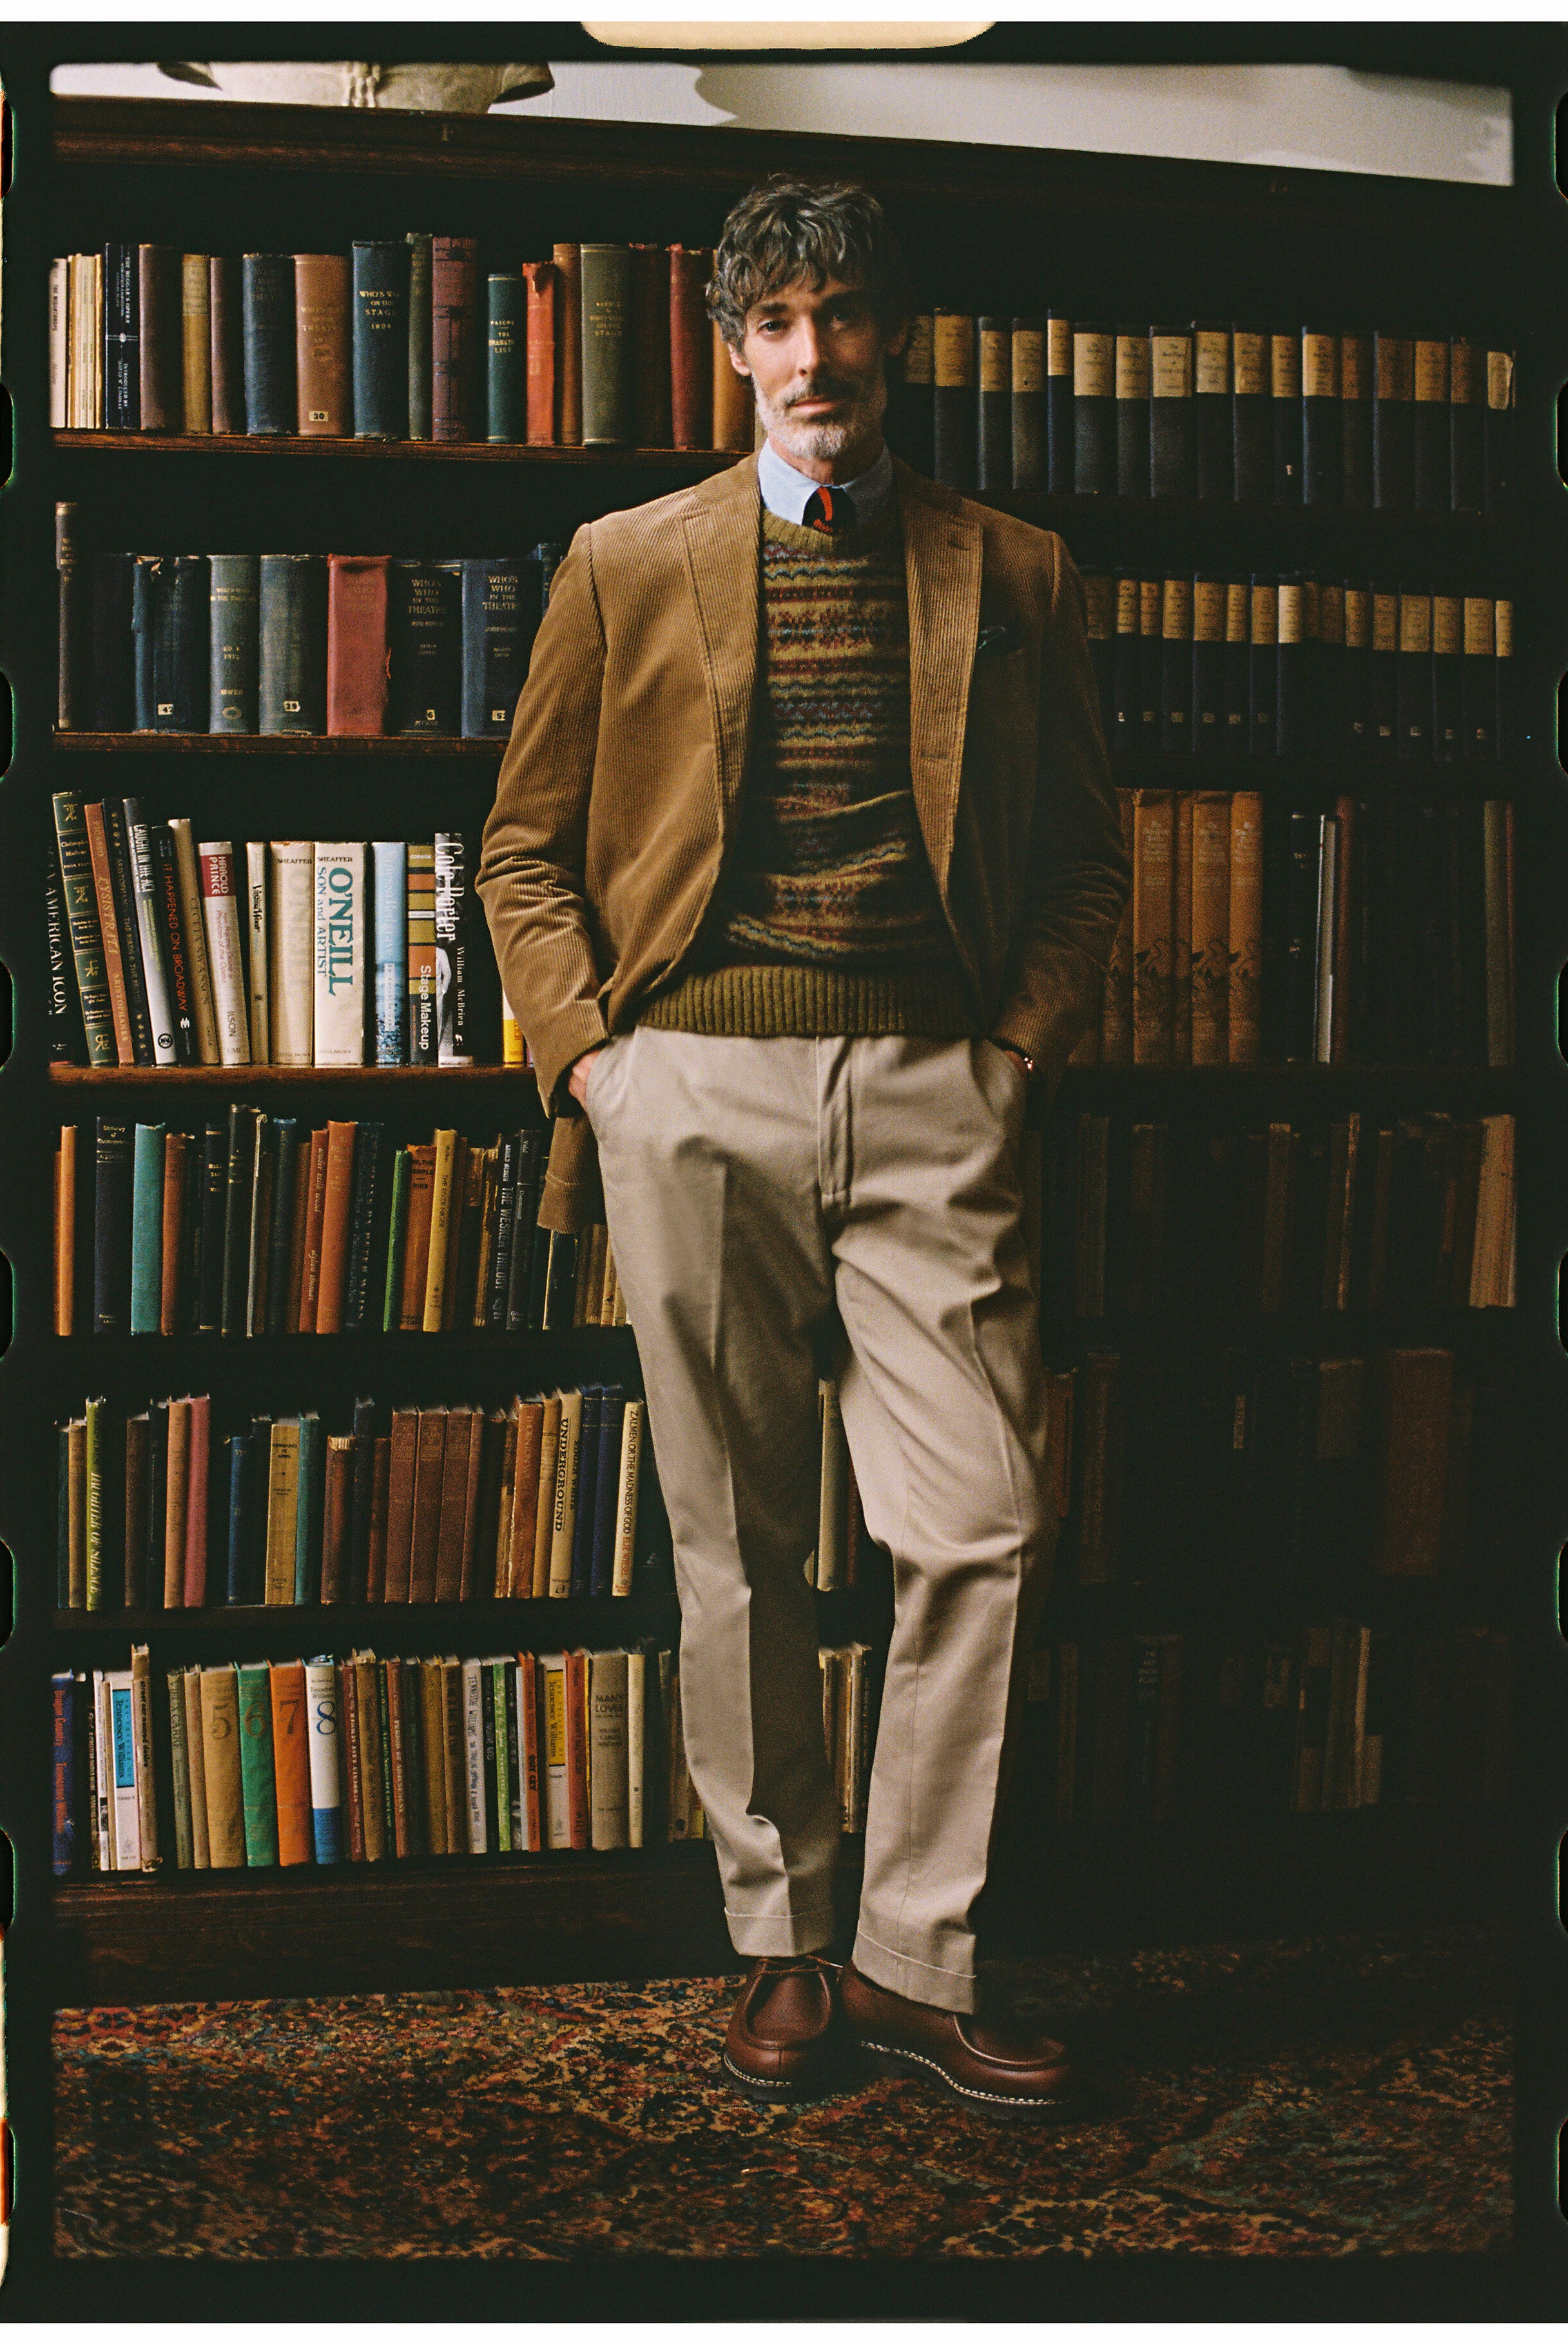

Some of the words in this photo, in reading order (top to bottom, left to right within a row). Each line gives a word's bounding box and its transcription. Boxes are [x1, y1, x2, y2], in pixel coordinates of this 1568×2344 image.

[95, 820, 105, 857] PICASSO
[135, 824, 150, 852] CAUGHT
[137, 853, 151, 864] IN
[209, 856, 221, 895] PRINCE
[218, 856, 229, 894] HAROLD
[436, 842, 465, 880] Cole
[140, 878, 156, 892] ACT
[316, 866, 327, 895] SON
[99, 875, 119, 954] LYSISTRATA
[164, 875, 179, 929] HAPPENED
[316, 898, 327, 921] and
[436, 886, 465, 942] Porter
[44, 887, 64, 971] AMERICAN
[126, 933, 134, 954] BIRDS
[169, 932, 180, 951] ON
[328, 867, 354, 996] O'NEILL
[316, 925, 327, 978] ARTIST
[456, 946, 465, 983] William
[52, 975, 68, 1016] ICON
[172, 953, 188, 1011] BROADWAY
[418, 964, 432, 1000] Stage
[112, 972, 129, 1042] ARISTOPHANES
[227, 1011, 237, 1037] ILSON
[457, 989, 466, 1026] McBrien
[418, 1002, 432, 1051] Makeup
[501, 1186, 514, 1205] THE
[498, 1208, 513, 1246] WESKER
[494, 1251, 508, 1290] TRILOGY
[627, 1456, 635, 1471] THE
[628, 1444, 637, 1455] OR
[556, 1417, 568, 1532] UNDERGROUND
[624, 1471, 635, 1506] MADNESS
[623, 1517, 632, 1535] GOD
[624, 1506, 632, 1517] OF
[622, 1536, 631, 1552] ELIE
[621, 1552, 630, 1577] WIESEL
[52, 1689, 66, 1716] Dragon
[116, 1698, 124, 1741] Tennessee
[244, 1701, 267, 1738] 6
[279, 1700, 300, 1735] 7
[316, 1700, 337, 1735] 8
[53, 1718, 66, 1747] Country
[211, 1703, 231, 1740] 5
[550, 1721, 558, 1758] Williams
[117, 1741, 126, 1778] Williams
[55, 1761, 67, 1801] Tennessee
